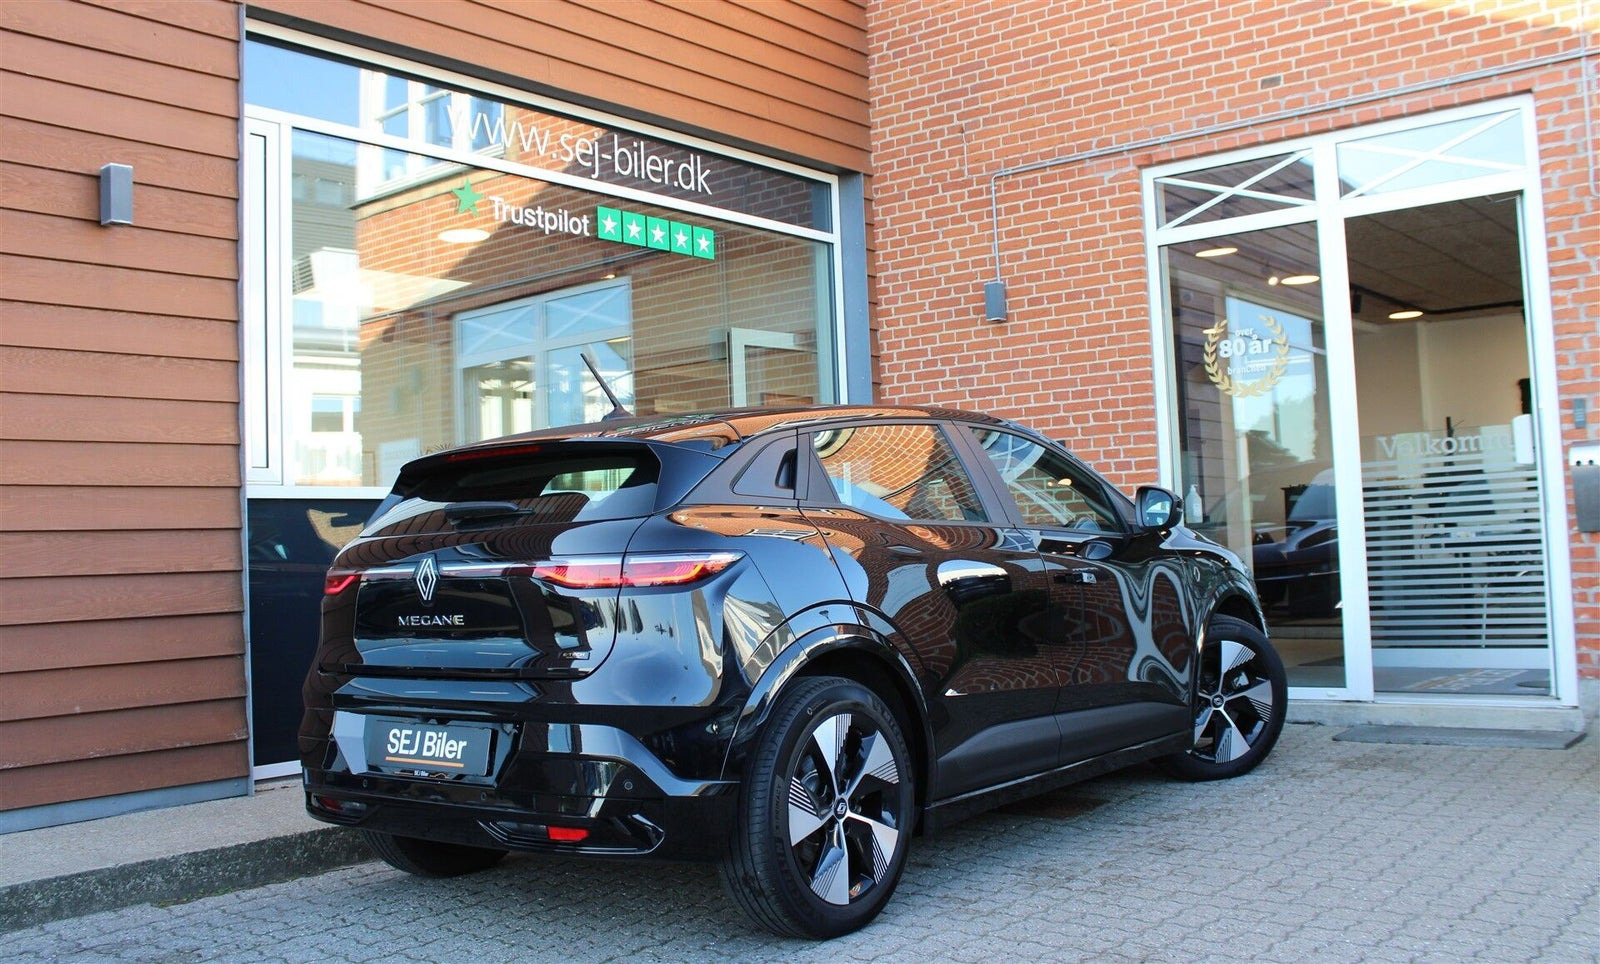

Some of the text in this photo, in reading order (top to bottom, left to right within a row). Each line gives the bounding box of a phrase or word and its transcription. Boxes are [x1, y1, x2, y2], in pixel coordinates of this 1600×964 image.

[446, 104, 712, 195] www.sej-biler.dk
[489, 196, 591, 237] Trustpilot
[1219, 334, 1272, 358] 80 år
[398, 615, 465, 626] MEGANE
[387, 728, 467, 760] SEJ Biler
